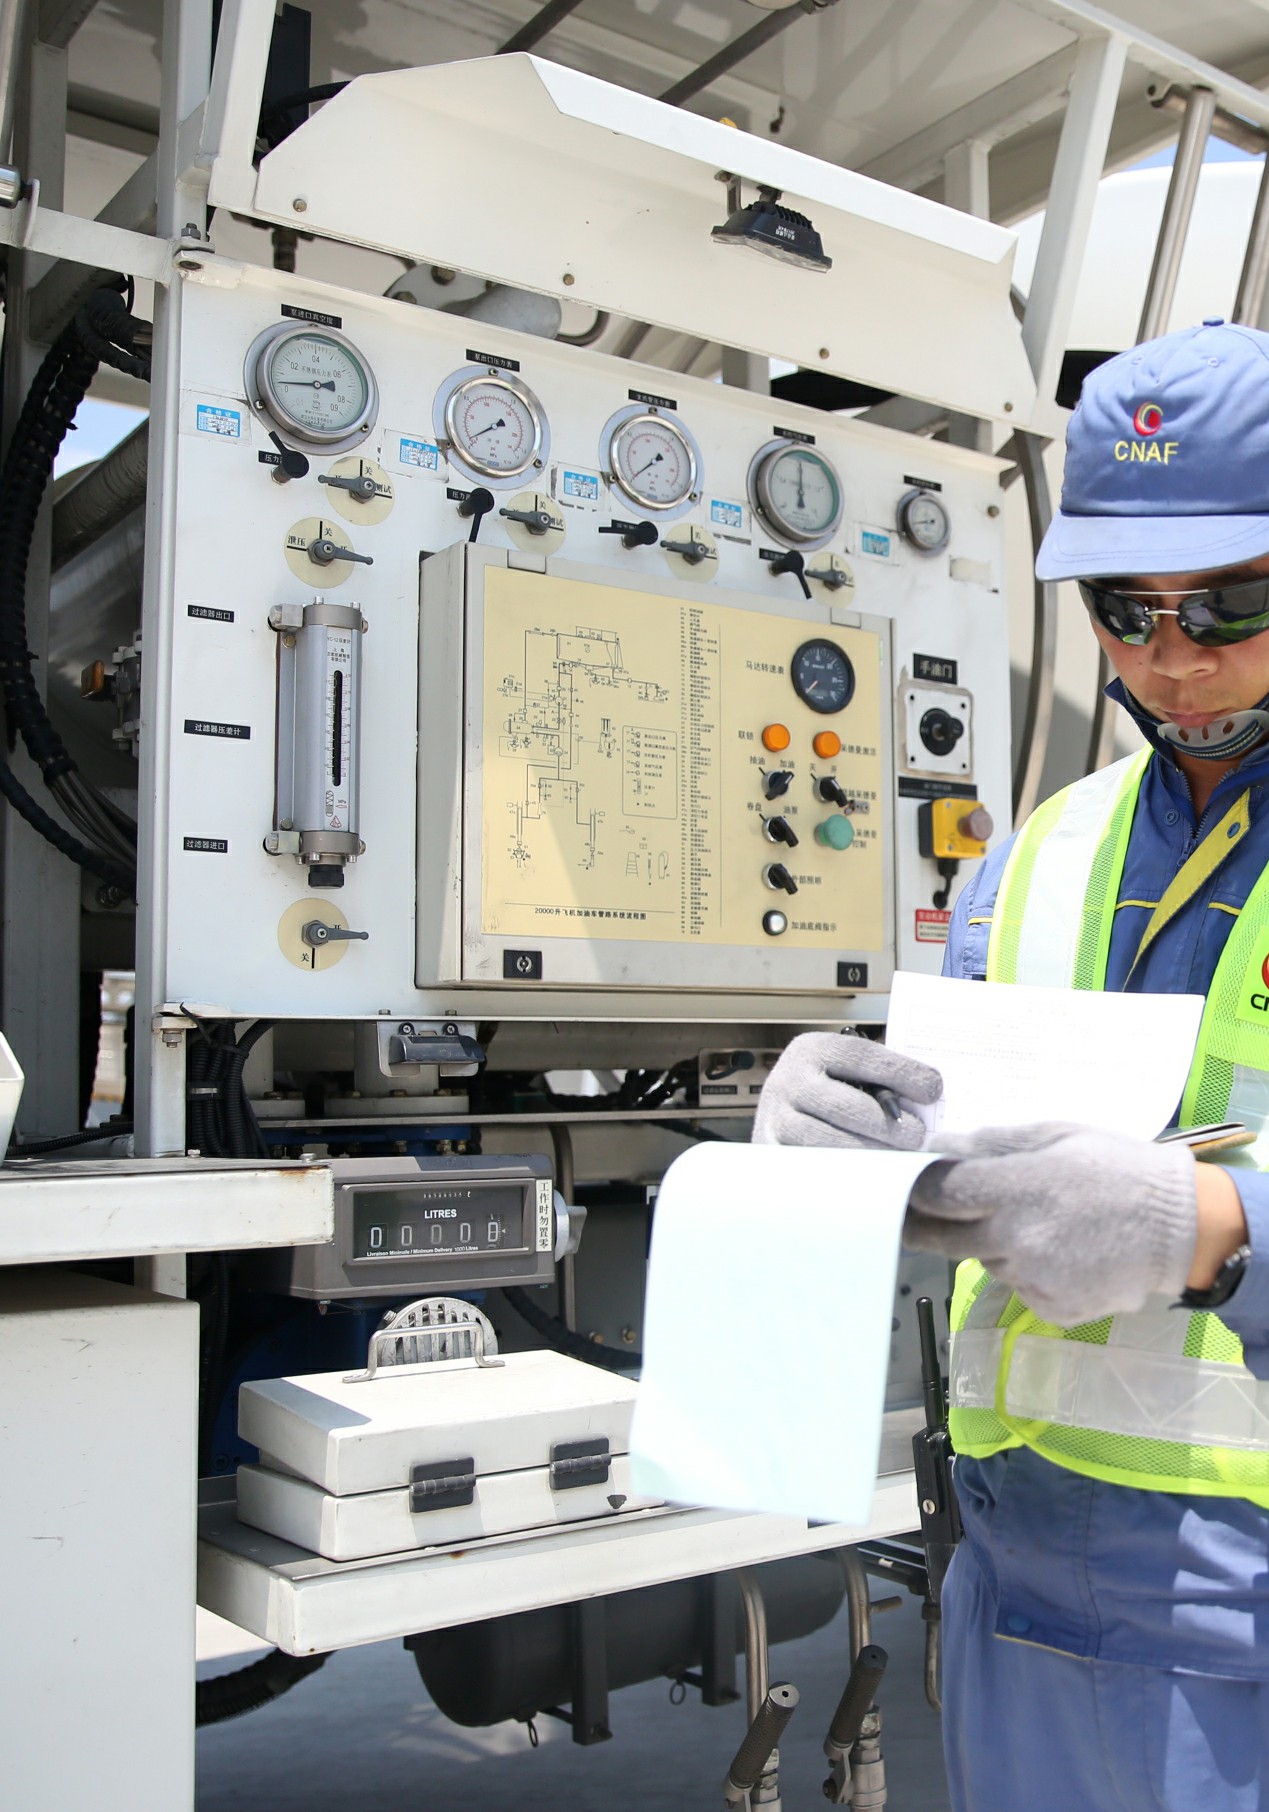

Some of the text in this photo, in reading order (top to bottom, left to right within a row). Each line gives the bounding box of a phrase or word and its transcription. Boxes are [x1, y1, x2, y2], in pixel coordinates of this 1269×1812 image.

[1114, 440, 1179, 466] CNAF
[364, 466, 373, 476] 关
[324, 527, 333, 537] 关
[191, 607, 231, 621] 过滤器出口
[745, 660, 785, 675] 马达转速表
[920, 660, 953, 679] 手油门
[194, 723, 242, 737] 过滤器压差计
[186, 839, 225, 851] 过滤器进口
[301, 953, 309, 962] 关
[424, 1209, 457, 1219] LITRES
[538, 1181, 550, 1249] 工作时勿置零
